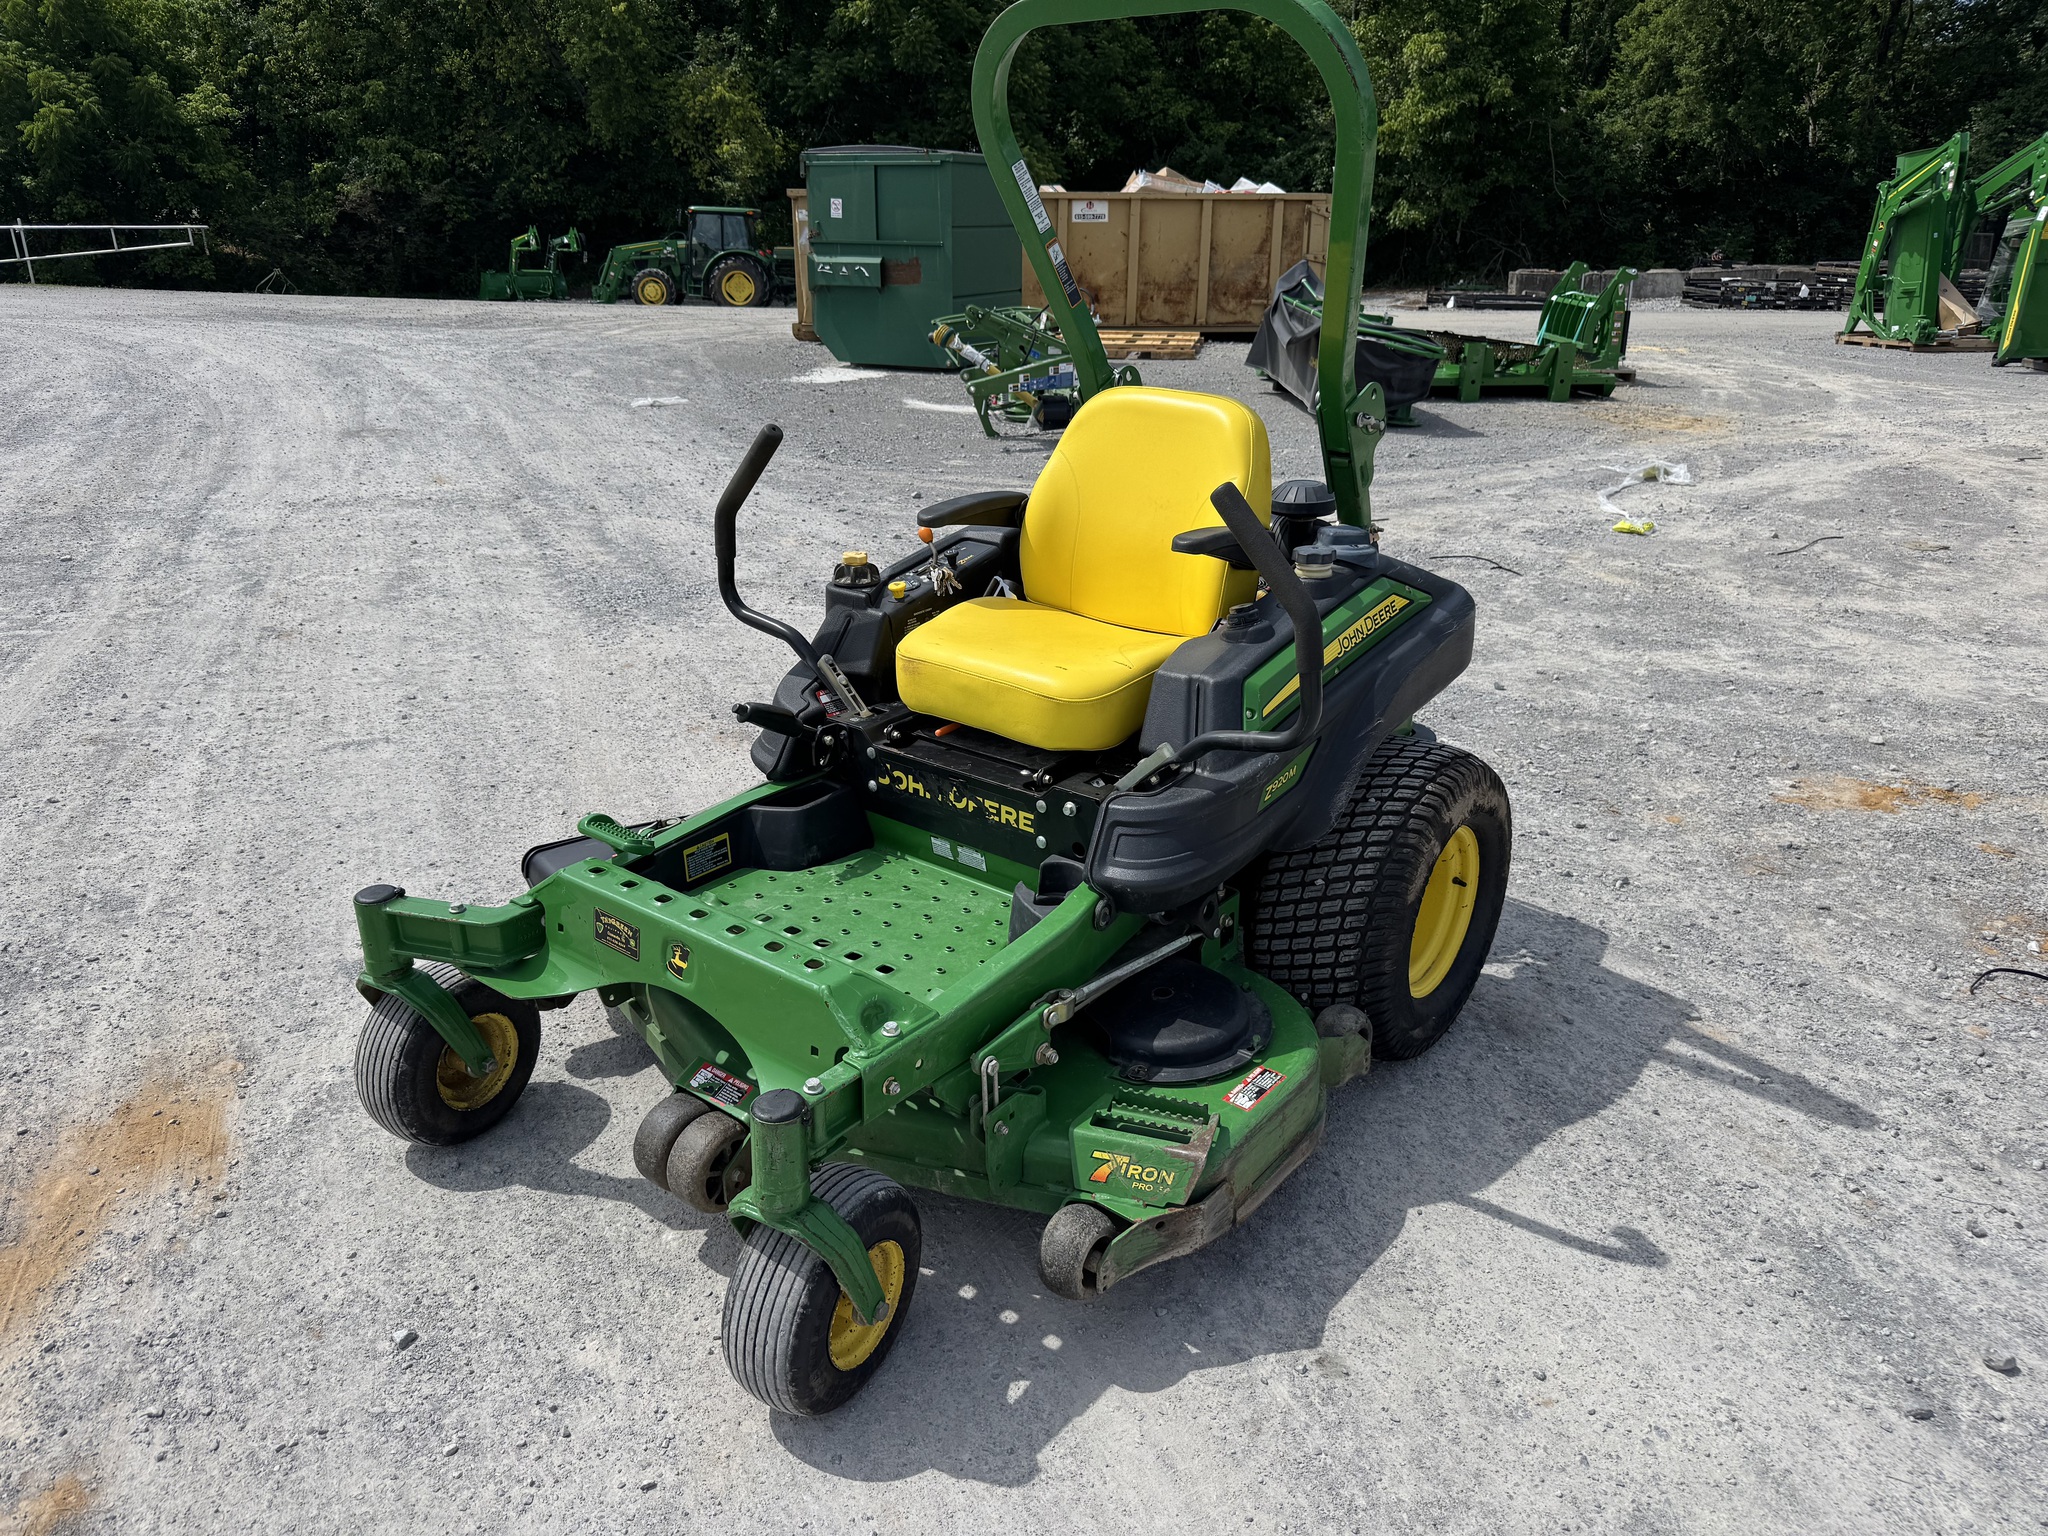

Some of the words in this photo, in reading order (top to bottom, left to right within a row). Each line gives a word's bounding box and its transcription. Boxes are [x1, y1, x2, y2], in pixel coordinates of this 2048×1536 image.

[1337, 625, 1365, 656] JOHN
[1364, 599, 1398, 633] DEERE
[878, 763, 942, 801] JOH
[1263, 765, 1297, 801] Z920M
[1131, 1181, 1154, 1192] PRO
